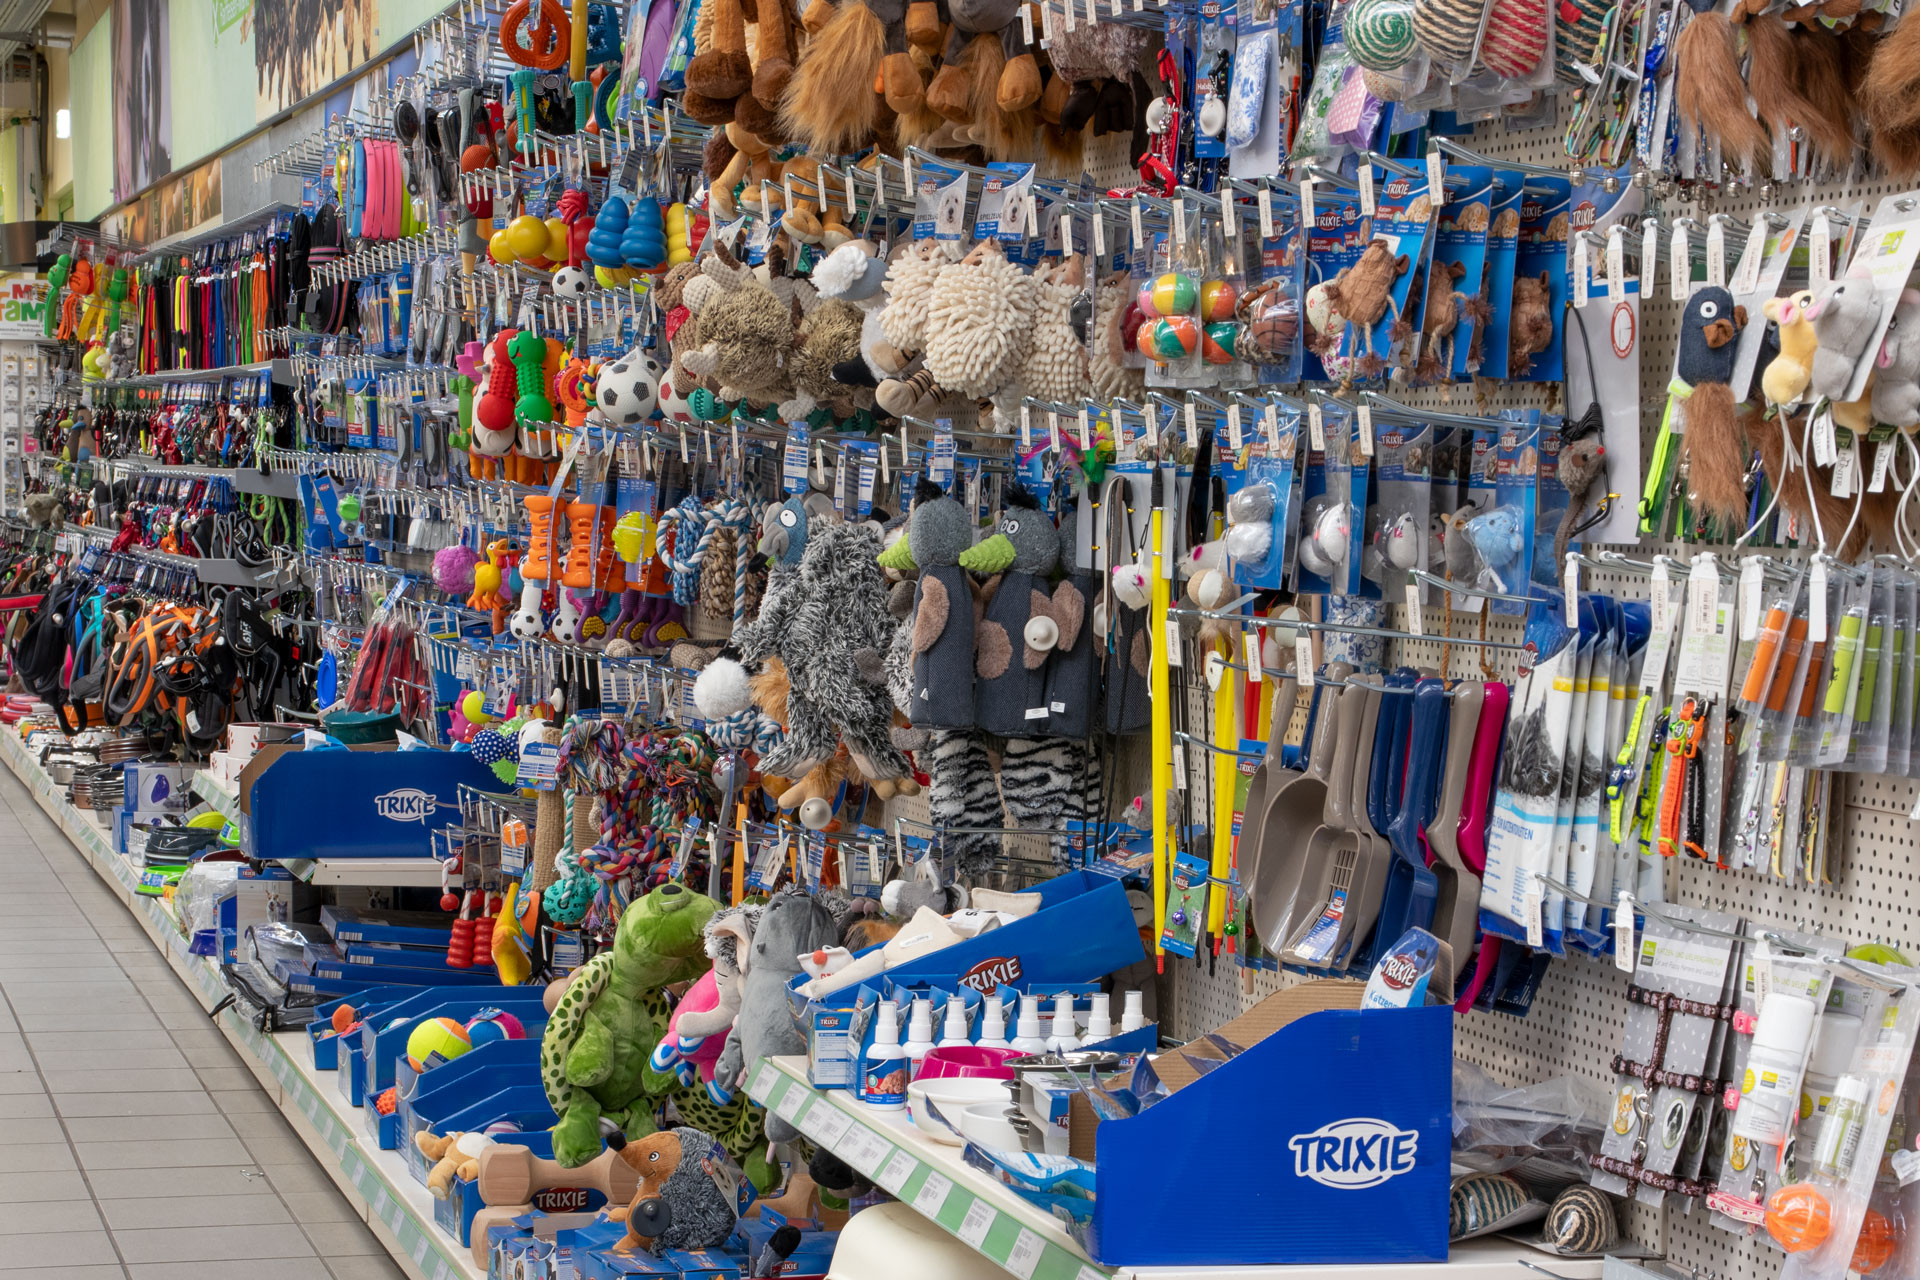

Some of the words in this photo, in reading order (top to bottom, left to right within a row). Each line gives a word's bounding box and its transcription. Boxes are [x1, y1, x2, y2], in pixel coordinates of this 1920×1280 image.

[1202, 5, 1220, 14] TRIXIE
[986, 182, 1002, 191] TRIXIE
[1387, 183, 1410, 195] TRIXIE
[1521, 206, 1542, 218] RIXIE
[1572, 207, 1596, 227] TRIXIE
[1315, 217, 1342, 228] TRIXIE
[1381, 435, 1404, 445] TRIXIE
[1240, 764, 1256, 773] TRIXIE
[377, 796, 436, 814] TRIXIE
[1175, 876, 1189, 888] TRIXIE
[958, 957, 1020, 992] TRIXIE
[1385, 957, 1417, 986] TRIXIE
[1293, 1133, 1415, 1174] TRIXIE
[536, 1191, 587, 1208] TRIXIE
